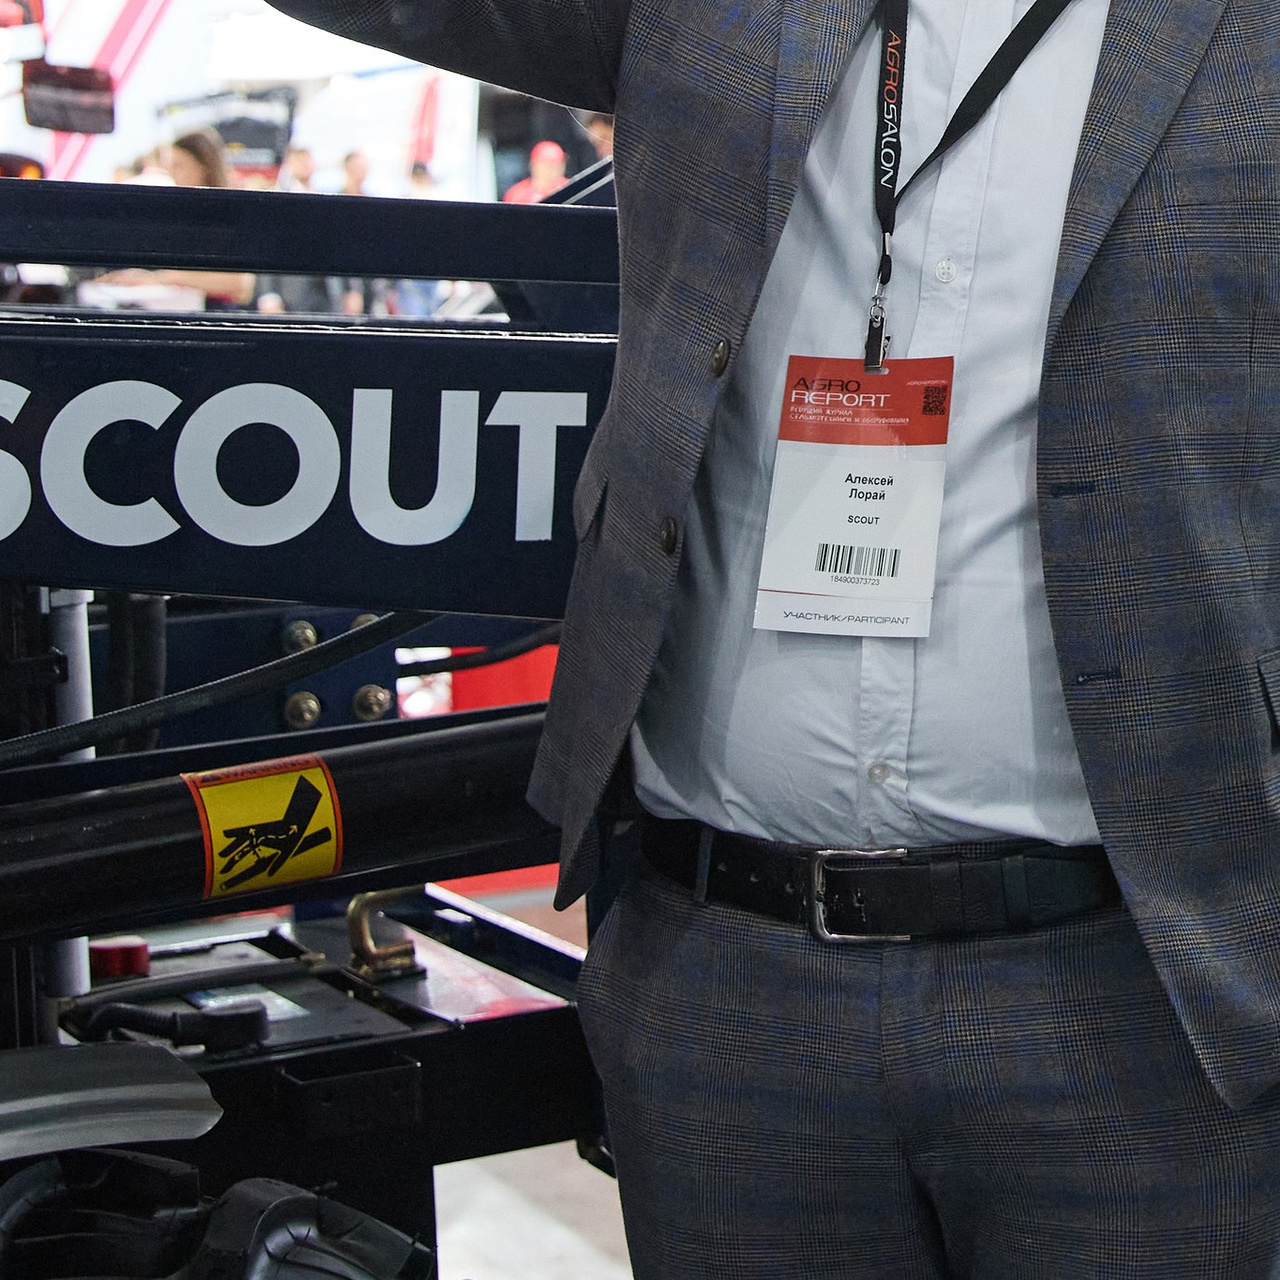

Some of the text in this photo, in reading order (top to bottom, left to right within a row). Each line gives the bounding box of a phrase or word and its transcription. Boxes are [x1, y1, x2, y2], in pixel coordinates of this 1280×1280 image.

[880, 29, 902, 188] AGROSALON
[793, 377, 861, 393] AGRO
[791, 390, 891, 407] REPORT
[845, 473, 894, 486] Алексей
[849, 488, 886, 501] Лорай
[847, 515, 880, 525] SCOUT
